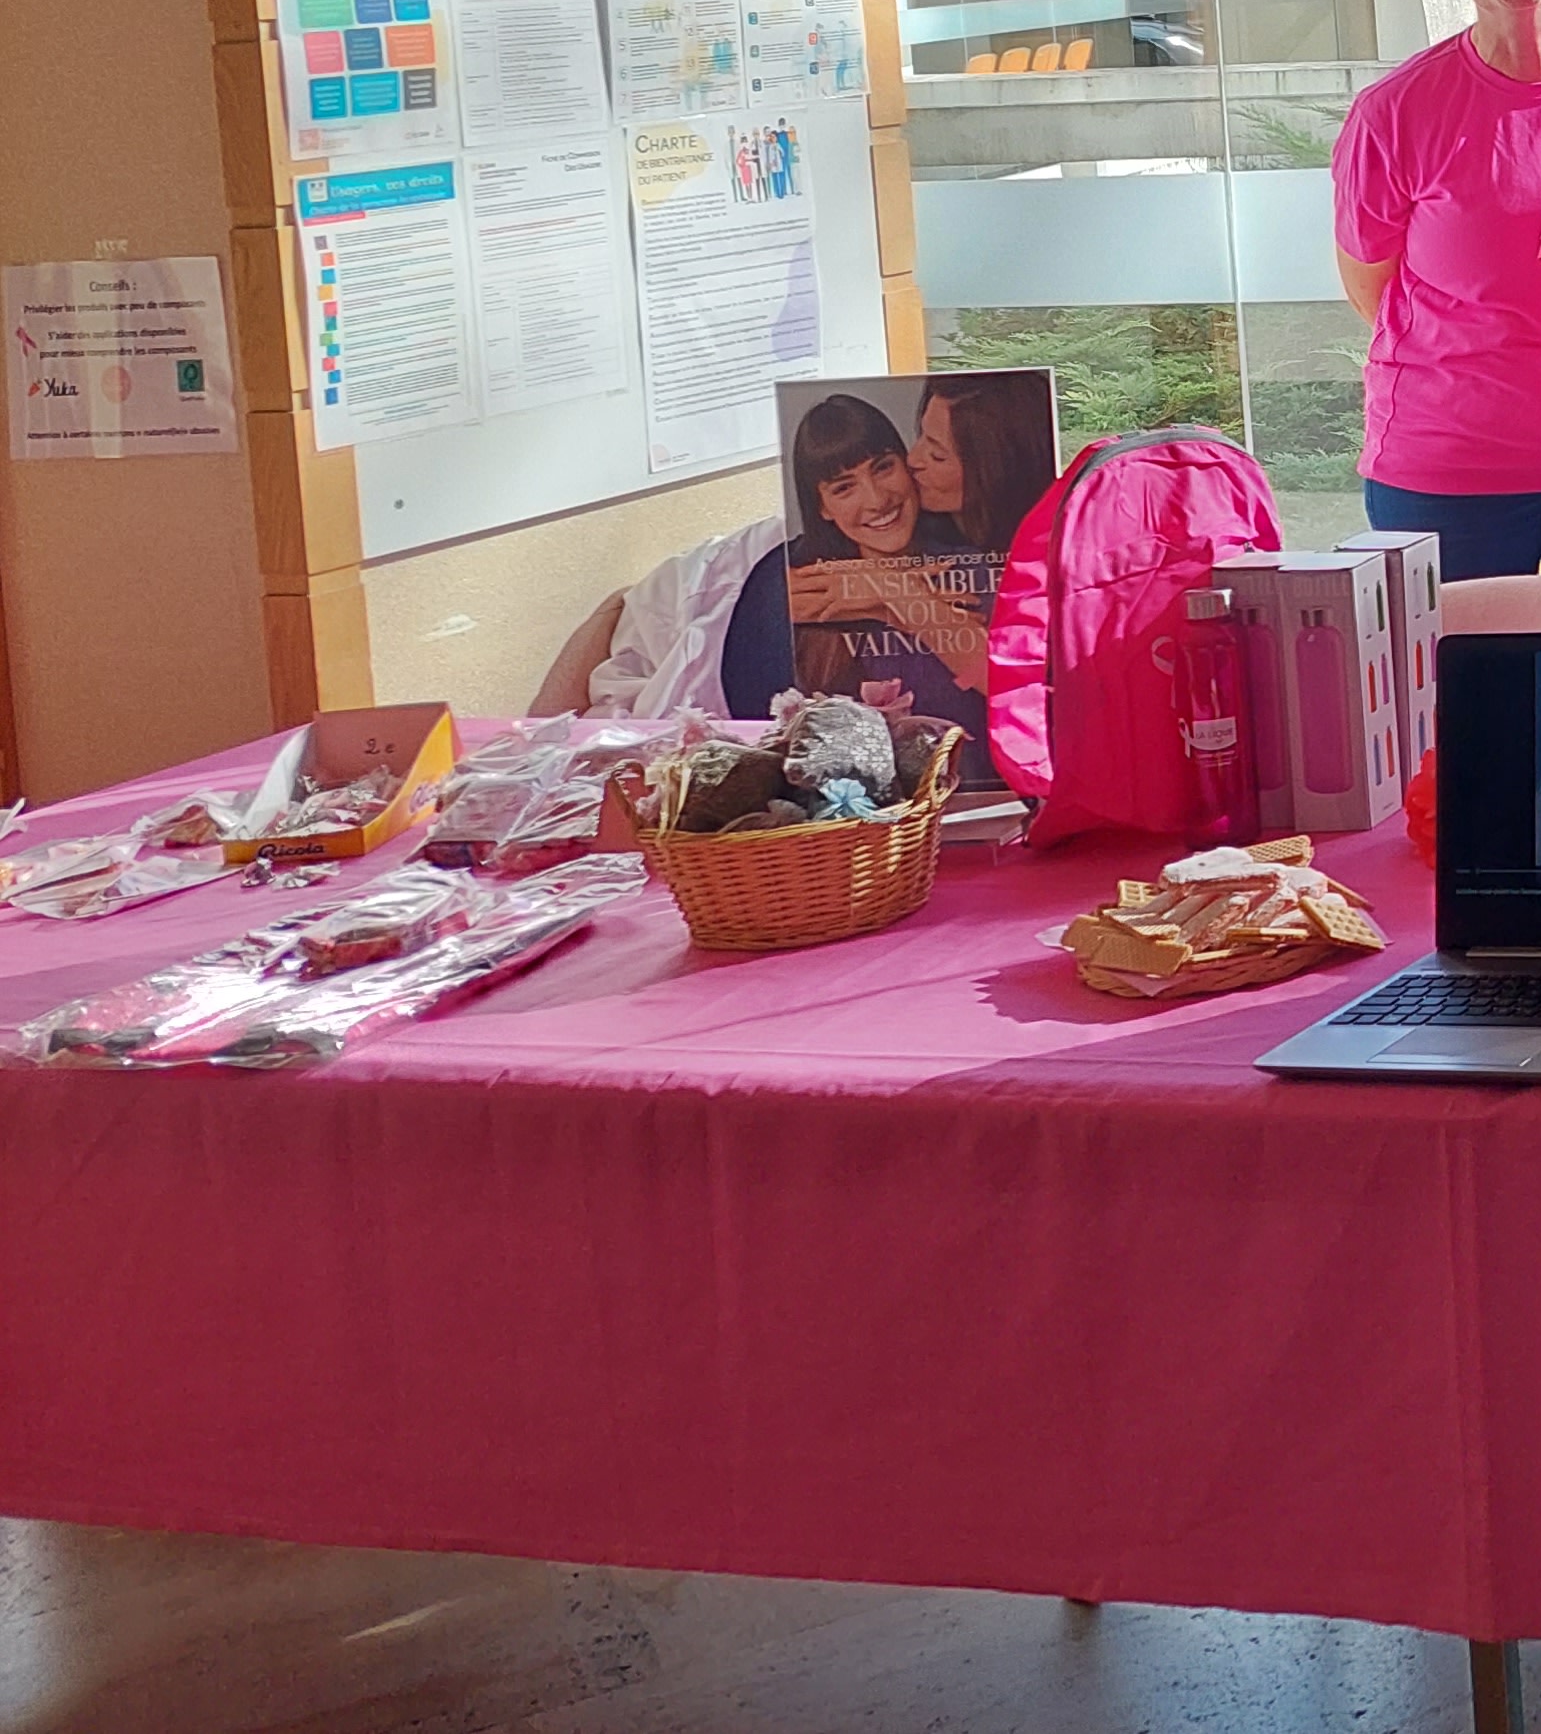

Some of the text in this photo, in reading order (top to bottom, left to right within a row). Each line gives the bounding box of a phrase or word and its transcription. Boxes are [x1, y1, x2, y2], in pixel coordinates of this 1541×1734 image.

[635, 134, 698, 153] CHARTE
[652, 171, 687, 183] PATIENT
[44, 378, 79, 397] Yuka
[815, 557, 875, 575] Agissons
[877, 554, 922, 569] contre
[923, 552, 935, 566] le
[935, 552, 985, 566] cancer
[985, 549, 1004, 563] du
[841, 567, 1006, 600] ENSEMBLE
[884, 599, 969, 627] NOUS
[841, 627, 990, 658] VAINCRON
[363, 737, 380, 755] 2
[257, 843, 326, 859] Ricola
